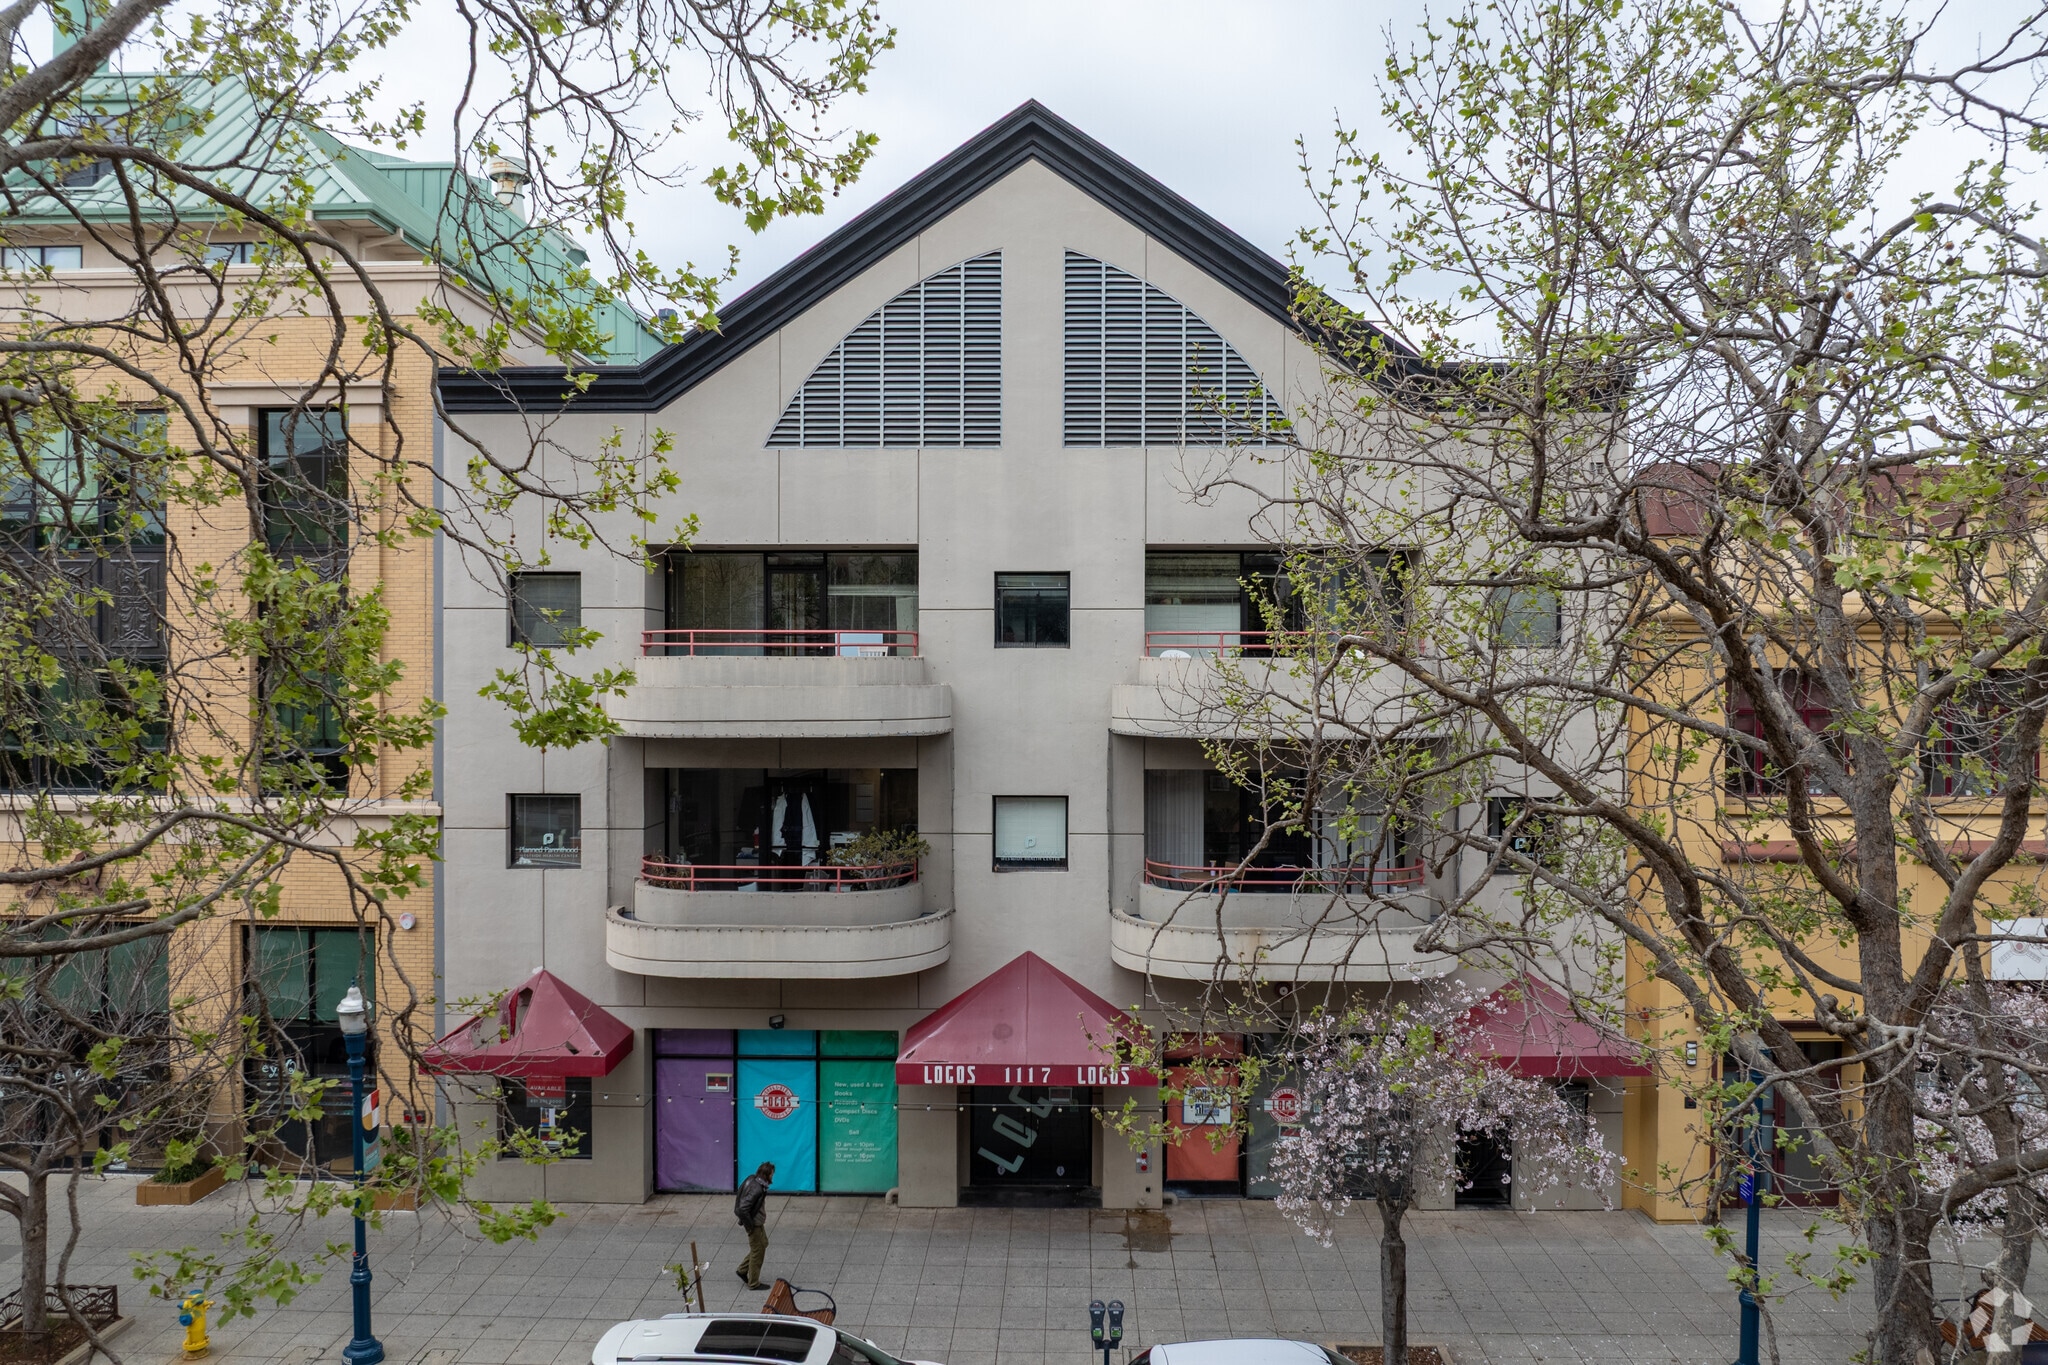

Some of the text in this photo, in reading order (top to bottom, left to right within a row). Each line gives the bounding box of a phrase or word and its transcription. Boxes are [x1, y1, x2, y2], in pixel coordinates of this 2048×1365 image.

[924, 1065, 976, 1084] LOGOS
[1004, 1067, 1051, 1083] 1117
[1077, 1066, 1130, 1085] LOGOS
[763, 1096, 791, 1107] LOGOS
